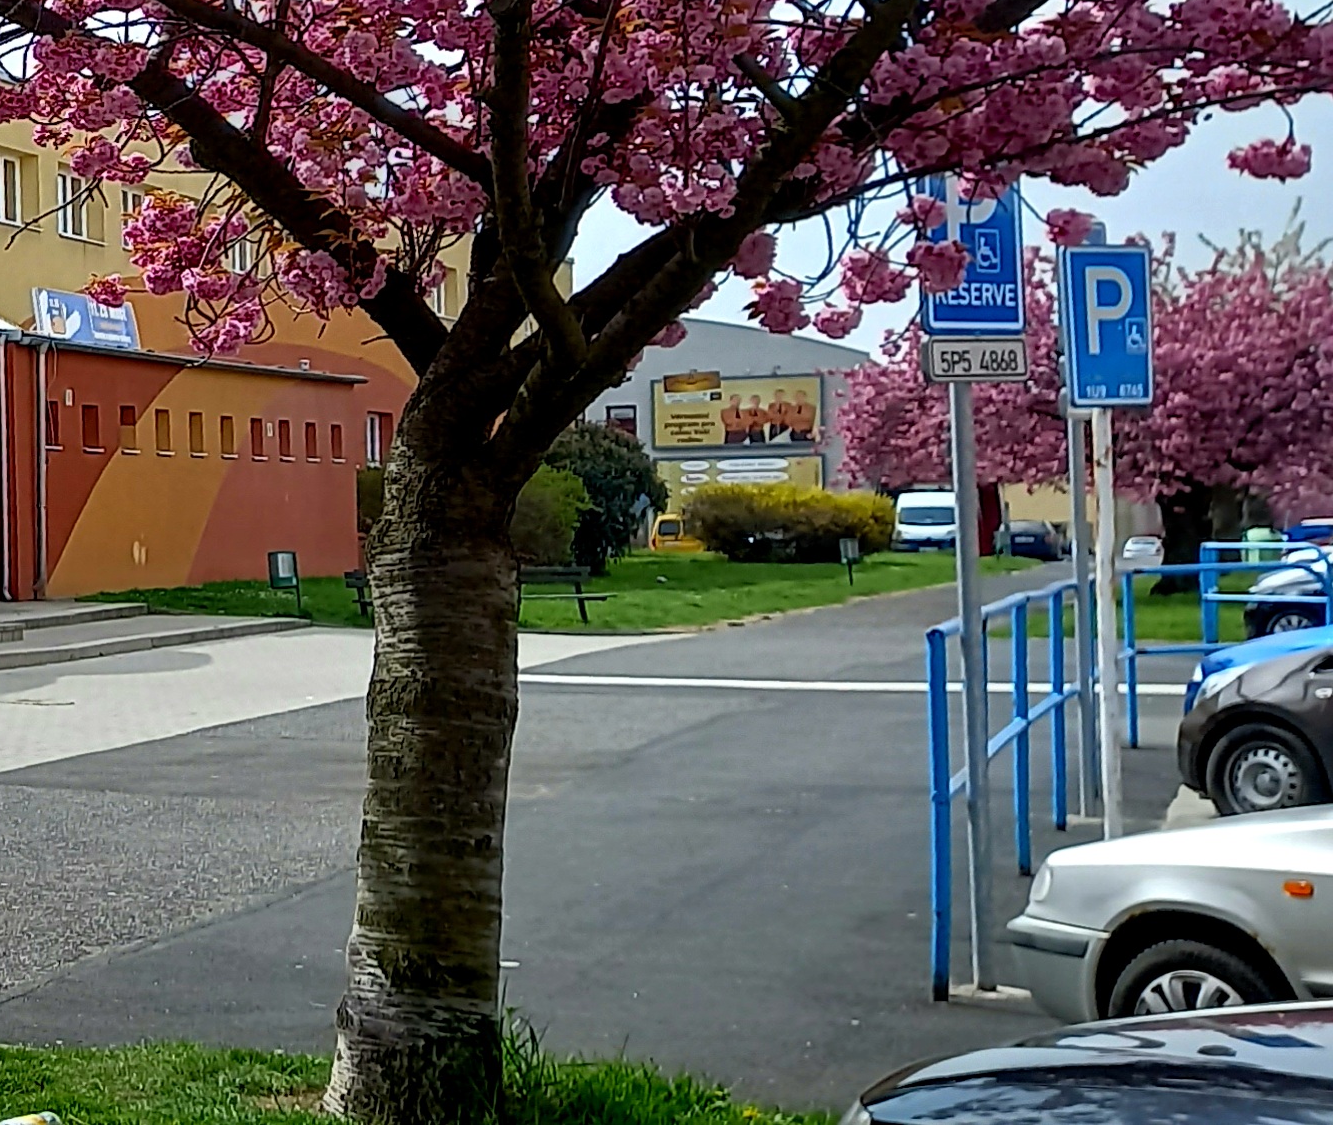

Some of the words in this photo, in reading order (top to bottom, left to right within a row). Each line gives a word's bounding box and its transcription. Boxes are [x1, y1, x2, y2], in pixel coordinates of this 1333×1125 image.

[935, 283, 1017, 307] RESERVE
[1085, 265, 1133, 355] P
[940, 350, 972, 373] 5P5
[979, 349, 1018, 372] 4868
